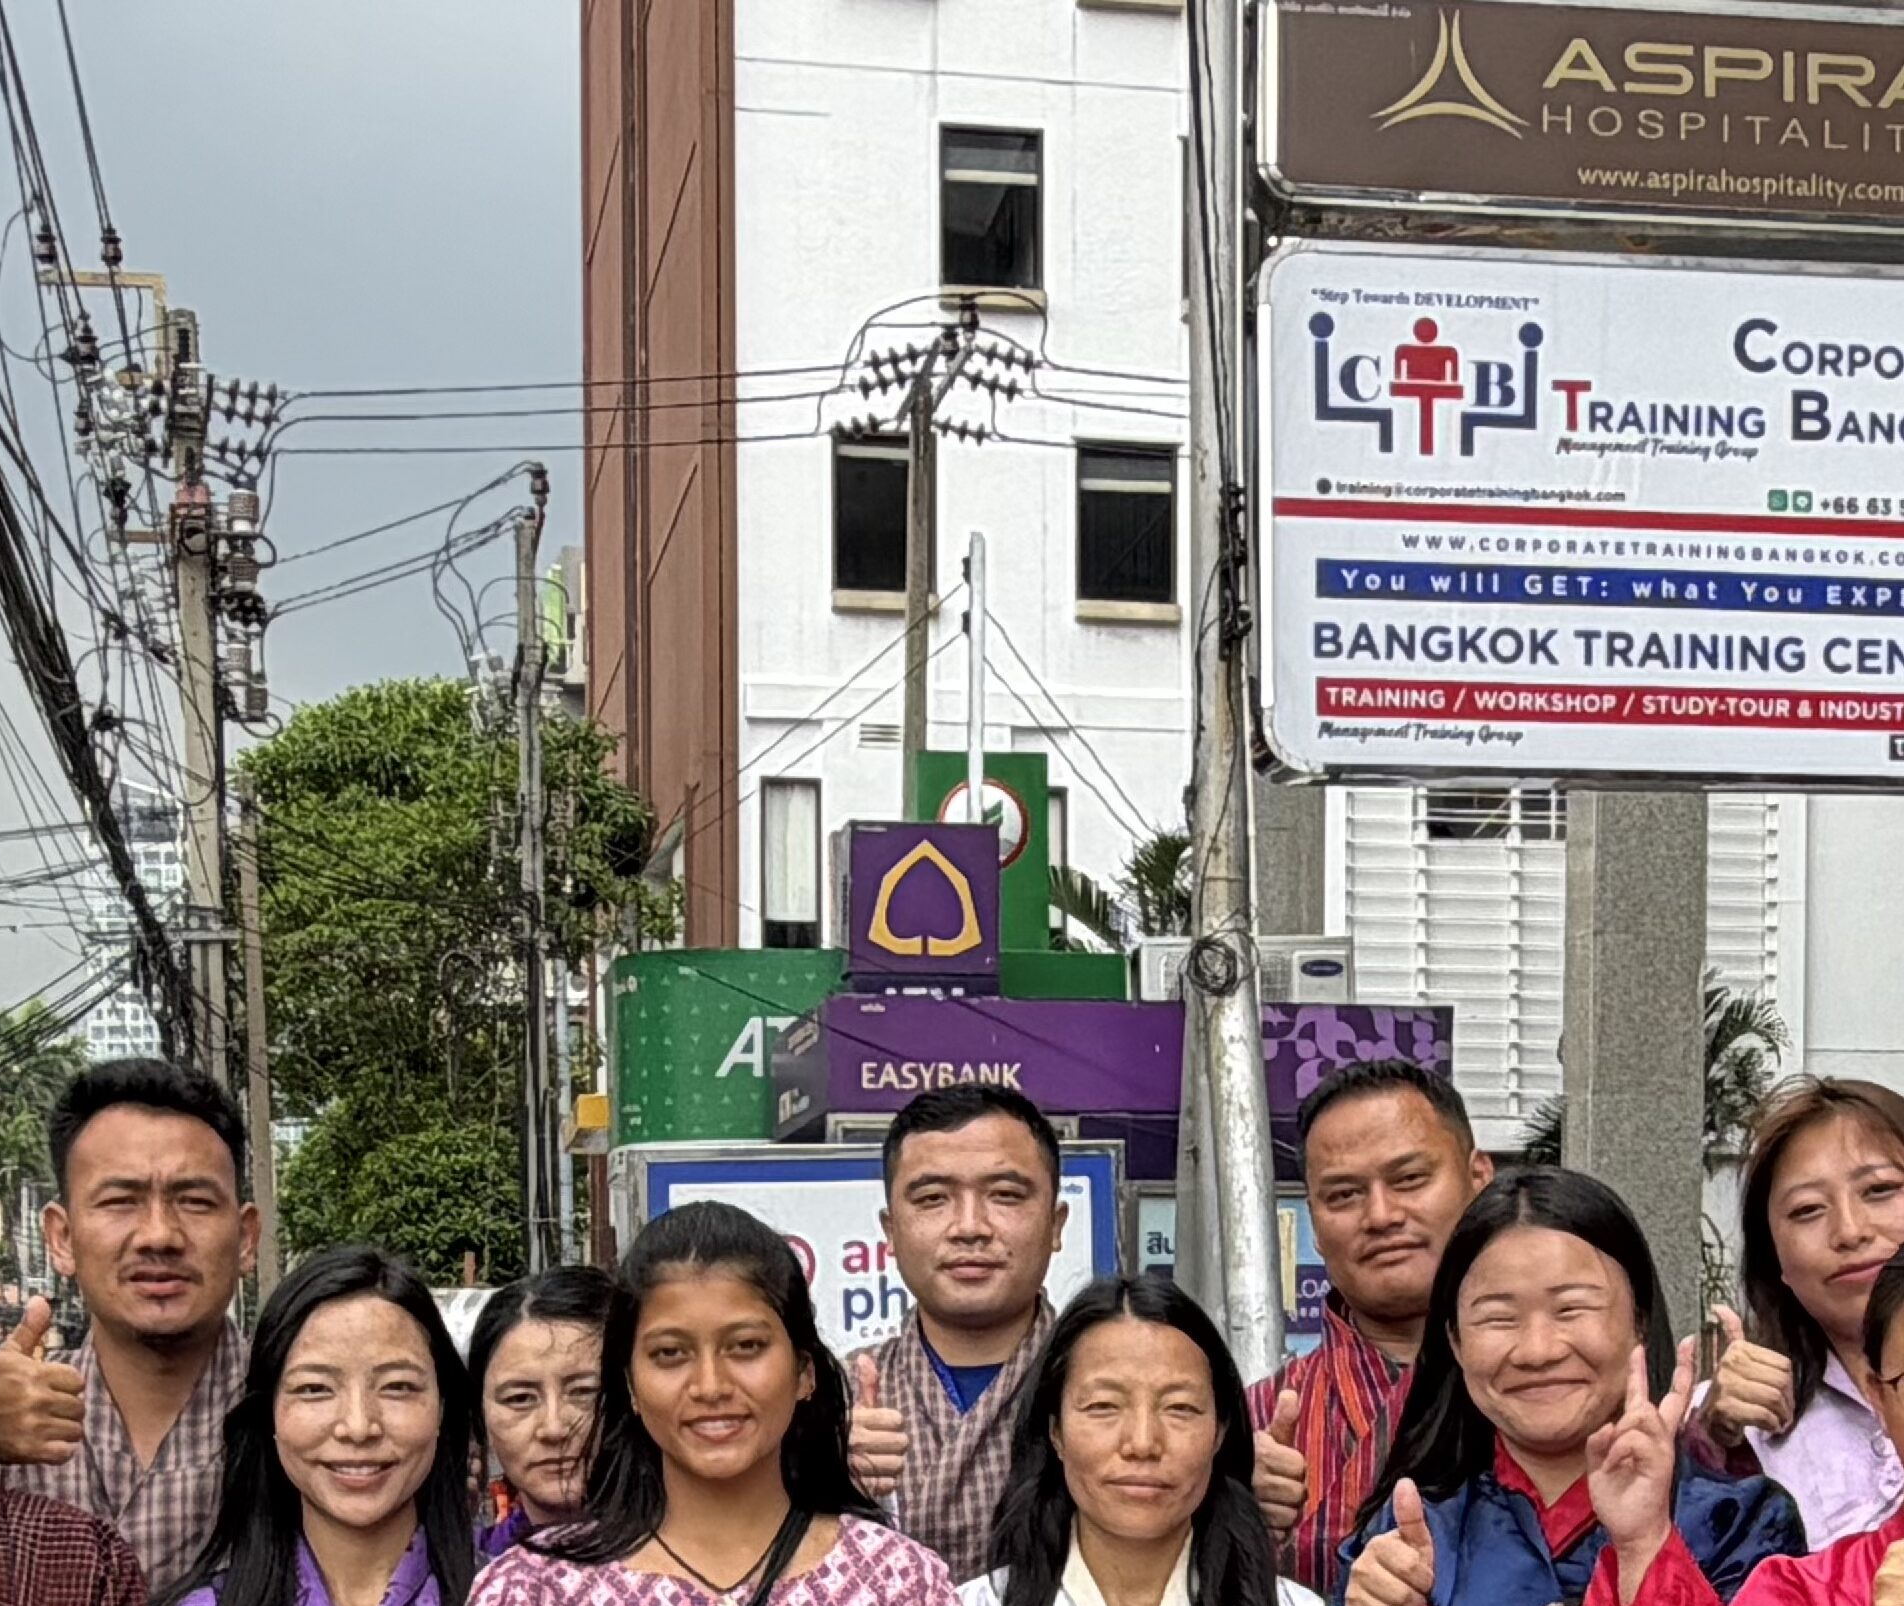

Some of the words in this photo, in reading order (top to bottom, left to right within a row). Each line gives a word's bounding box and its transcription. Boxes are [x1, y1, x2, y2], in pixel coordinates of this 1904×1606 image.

[1551, 379, 1767, 439] TRAINING
[1650, 438, 1712, 462] Training
[1819, 497, 1859, 515] +66
[1341, 568, 1406, 591] You
[1430, 570, 1500, 593] will
[1523, 574, 1608, 597] GET:
[1632, 577, 1718, 601] what
[1740, 580, 1804, 604] You
[1313, 621, 1560, 665] BANGKOK
[1573, 629, 1807, 673] TRAINING
[1325, 686, 1446, 711] TRAINING
[1474, 690, 1616, 714] WORKSHOP
[1642, 694, 1790, 719] STUDY-TOUR
[1796, 699, 1813, 720] &
[860, 1061, 1023, 1091] EASYBANK
